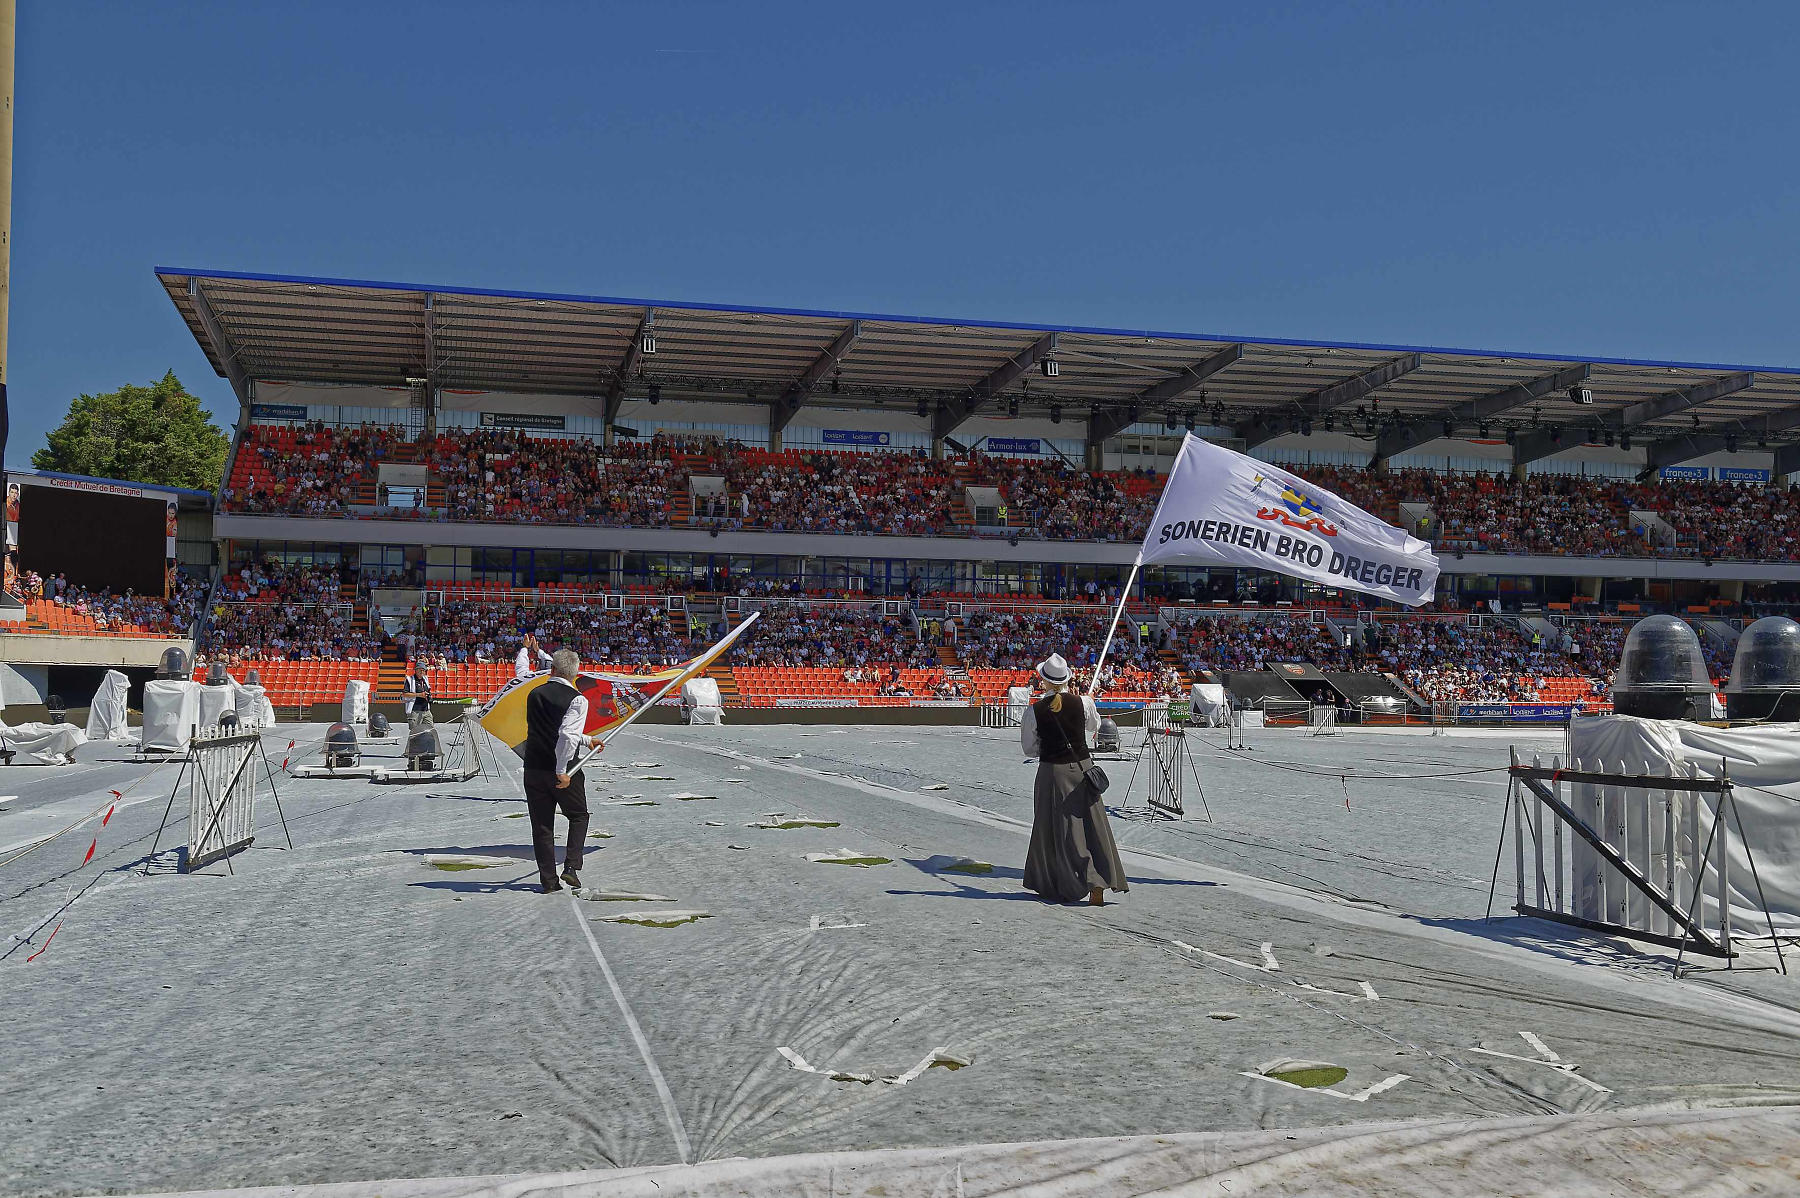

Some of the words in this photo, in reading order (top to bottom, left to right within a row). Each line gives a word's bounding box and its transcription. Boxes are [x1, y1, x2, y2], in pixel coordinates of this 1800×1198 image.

[109, 485, 140, 496] Bretagne
[1159, 519, 1270, 552] SONERIEN
[1275, 535, 1324, 567] BRO
[1327, 551, 1424, 591] DREGER
